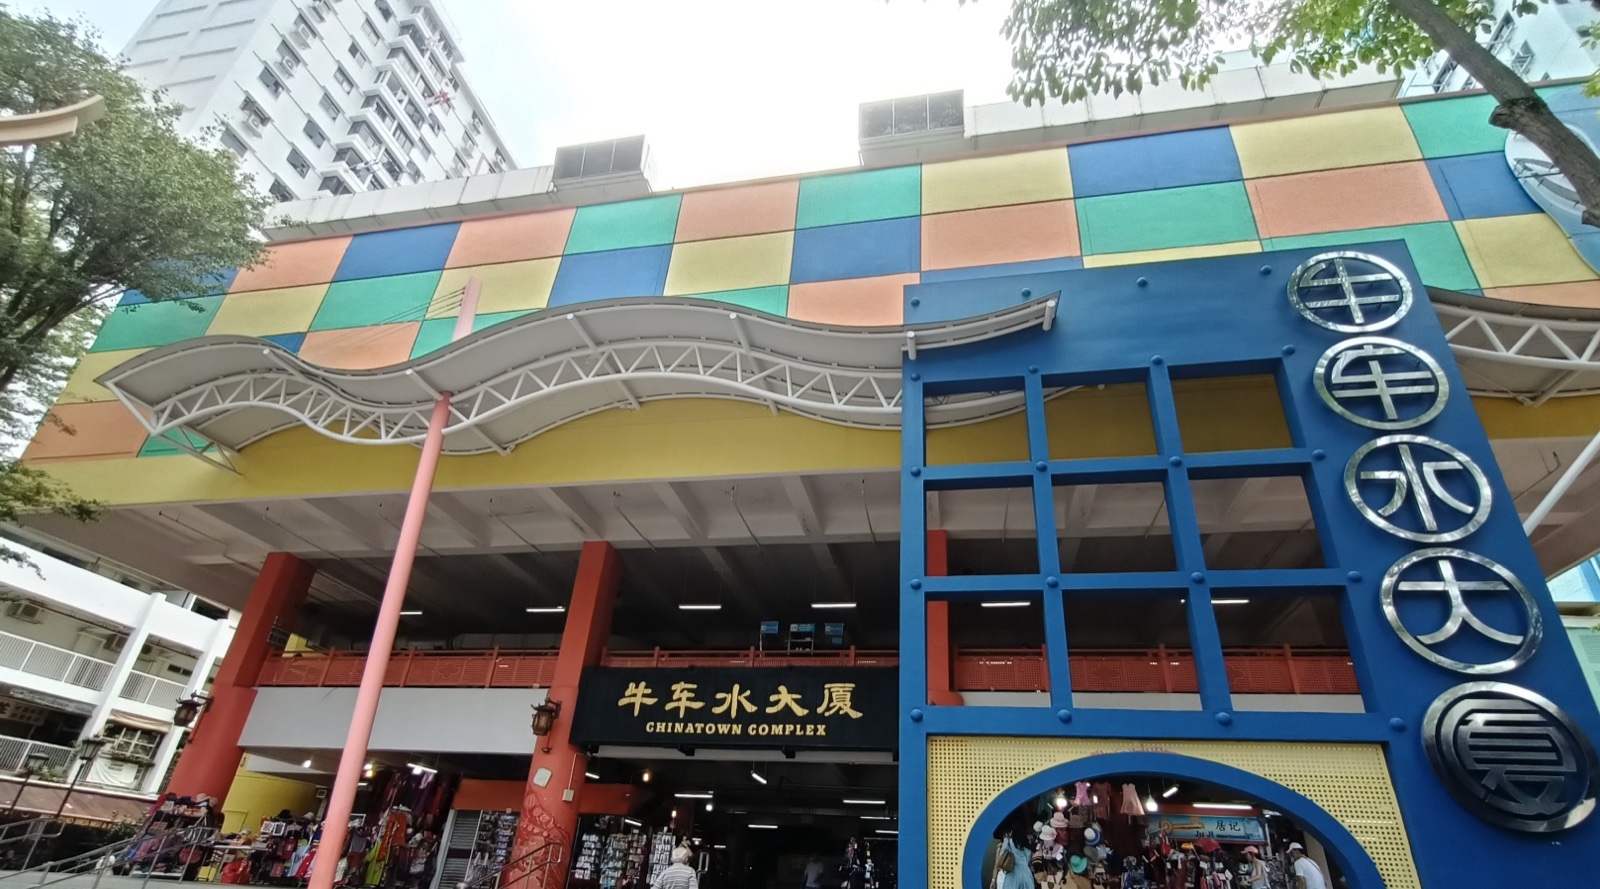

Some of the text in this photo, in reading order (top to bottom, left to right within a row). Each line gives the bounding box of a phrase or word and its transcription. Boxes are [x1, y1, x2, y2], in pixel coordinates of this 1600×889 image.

[617, 681, 863, 719] 牛车水大厦
[645, 721, 827, 736] CHINATOWN COMPLEX
[1216, 820, 1241, 832] 居记
